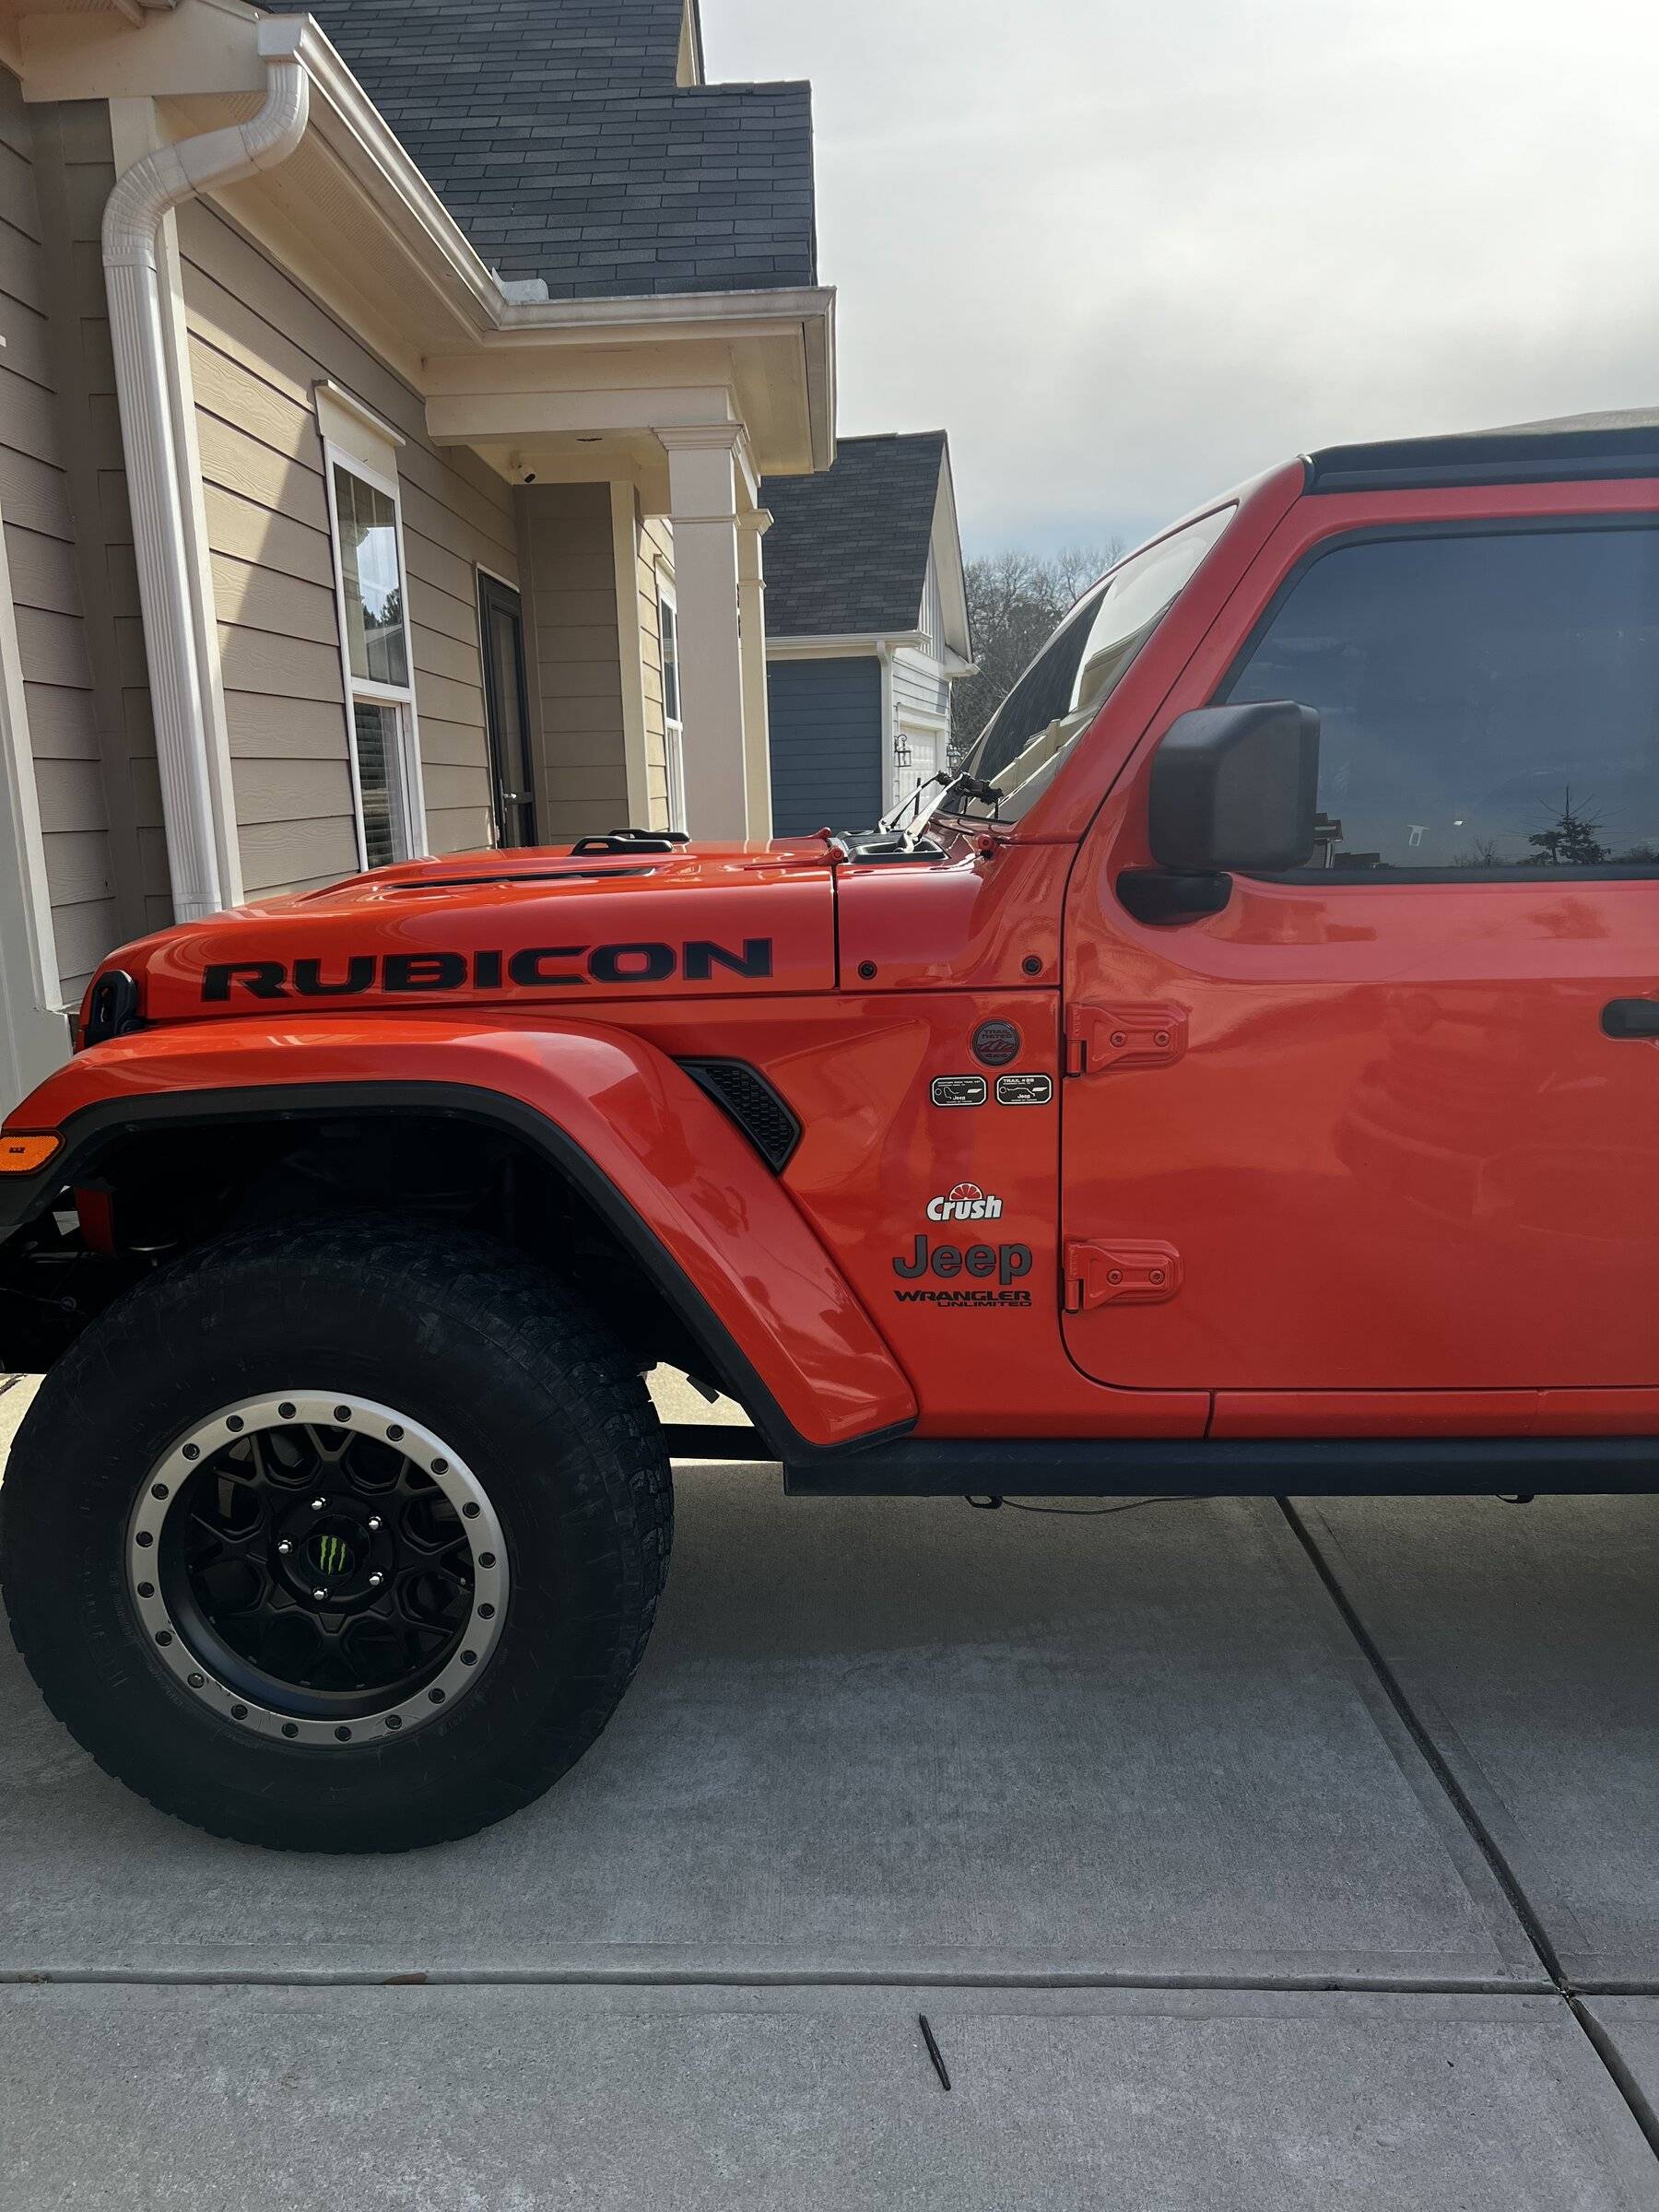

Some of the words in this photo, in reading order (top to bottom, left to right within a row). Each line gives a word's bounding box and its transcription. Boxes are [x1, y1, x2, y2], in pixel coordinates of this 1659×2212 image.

[201, 938, 773, 1002] RUBICON
[926, 1195, 1003, 1222] Crush
[892, 1234, 1033, 1285] Jeep
[893, 1289, 1031, 1301] WRANGLER
